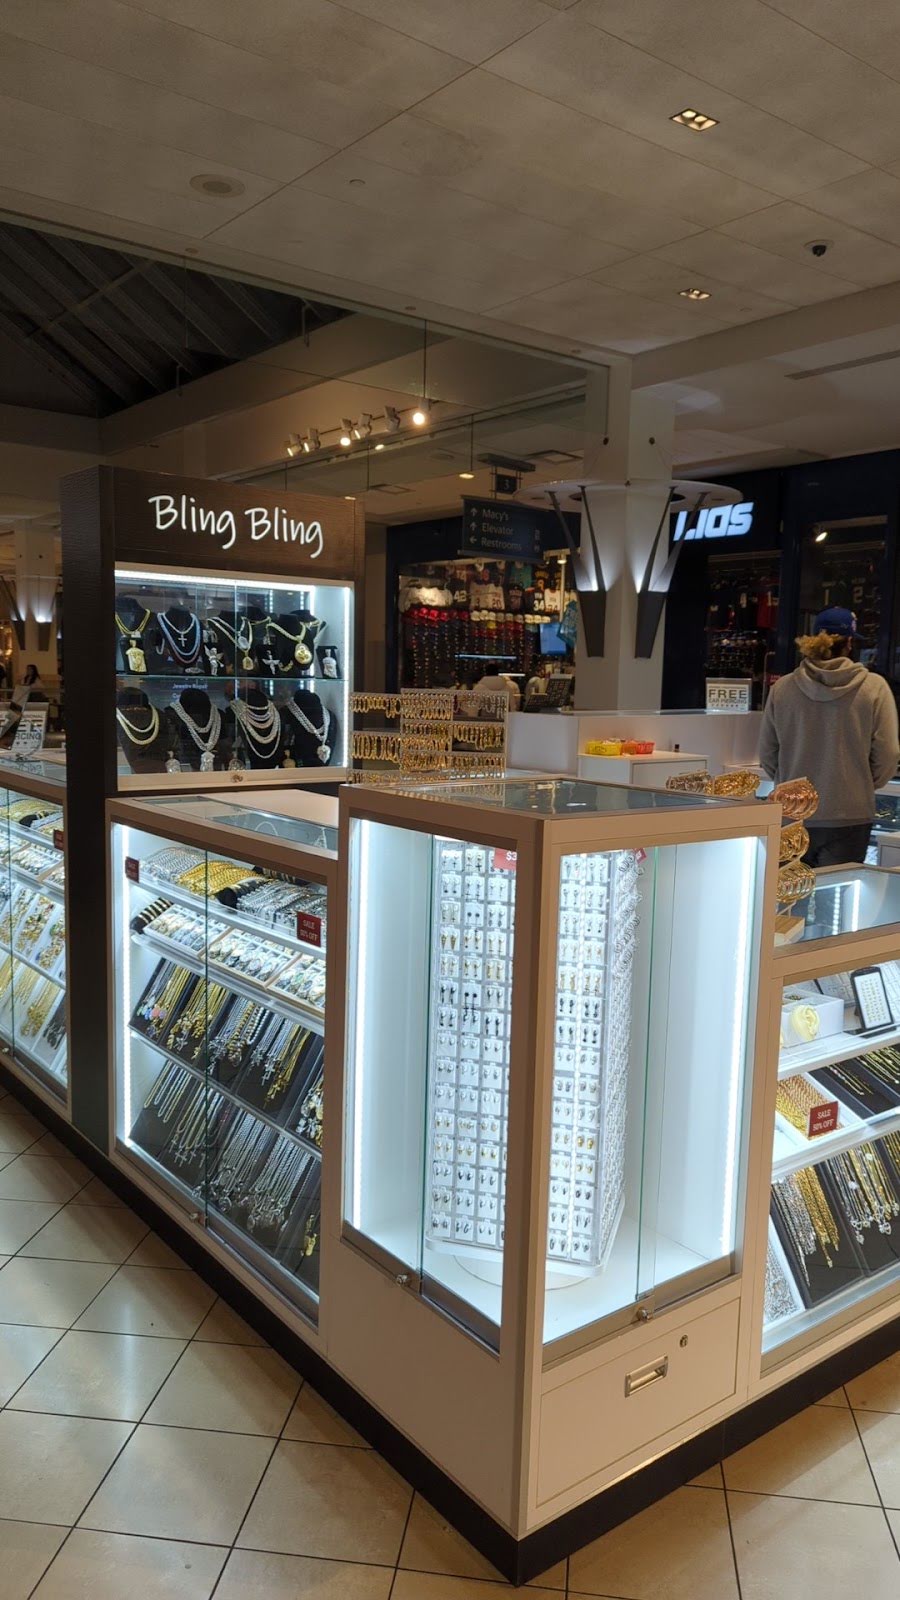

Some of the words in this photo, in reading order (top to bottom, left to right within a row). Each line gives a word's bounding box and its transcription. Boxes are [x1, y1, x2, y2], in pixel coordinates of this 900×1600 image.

[482, 509, 509, 521] Macy's
[148, 494, 236, 550] Bling
[244, 506, 324, 559] Bling
[482, 523, 513, 535] Elevator
[481, 537, 523, 551] Restrooms
[533, 600, 544, 611] 34
[708, 689, 747, 699] FREE
[817, 1109, 831, 1119] SALE
[823, 1119, 834, 1128] OFF
